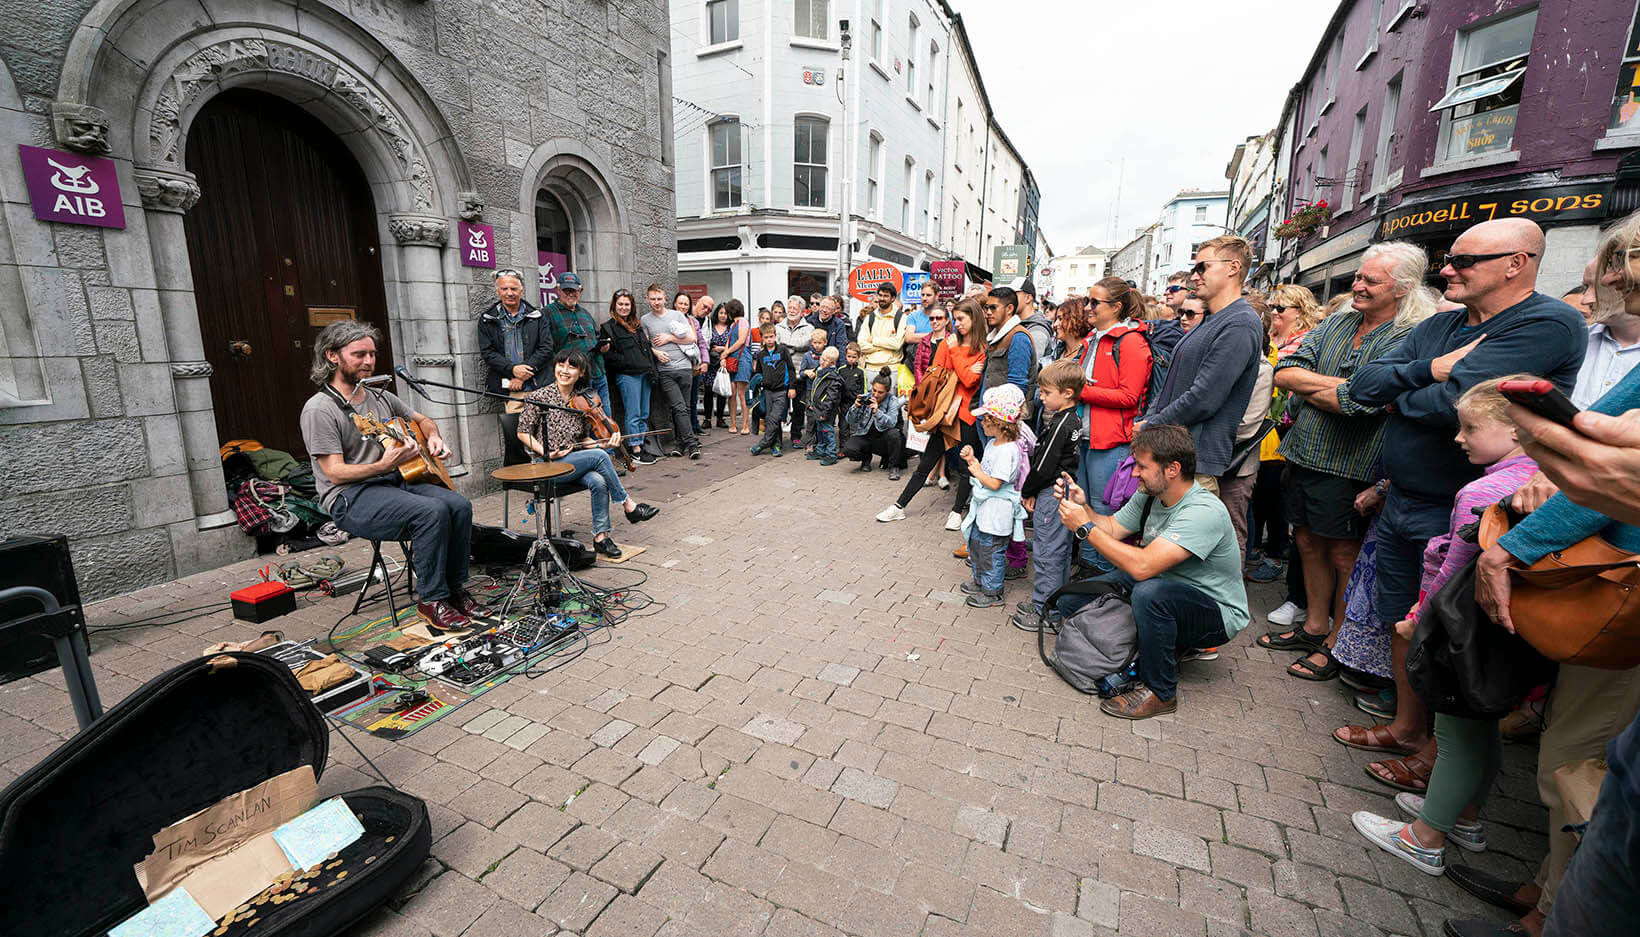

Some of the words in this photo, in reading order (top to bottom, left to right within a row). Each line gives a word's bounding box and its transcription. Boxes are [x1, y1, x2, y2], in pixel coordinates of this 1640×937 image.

[1467, 134, 1495, 150] SHOP
[53, 193, 106, 218] AIB
[469, 249, 490, 262] AIB
[856, 268, 893, 281] LALLY
[159, 836, 198, 860] TIM
